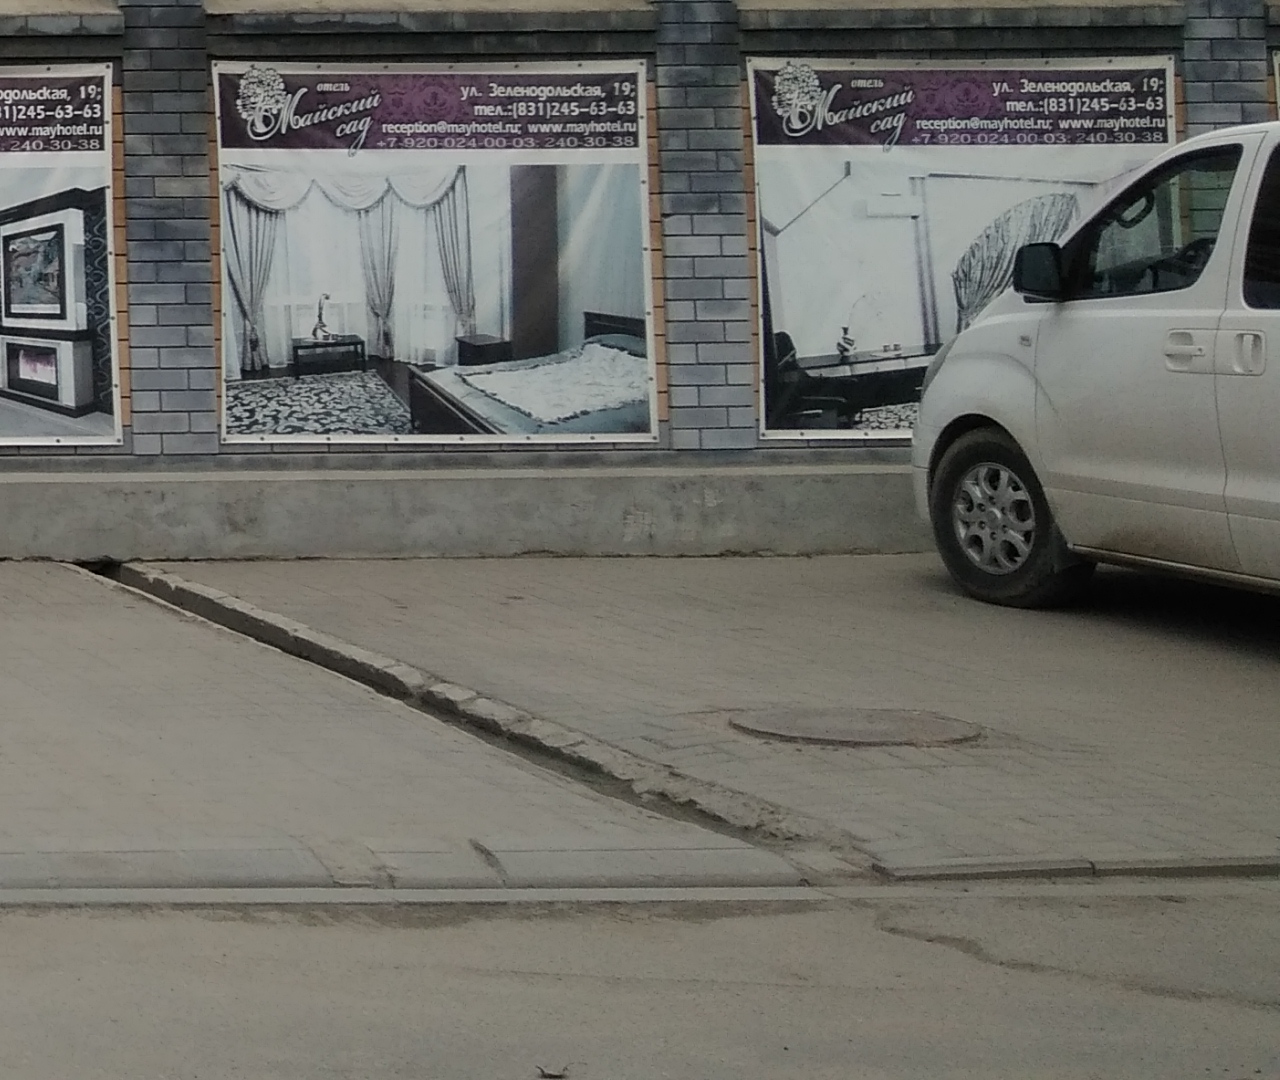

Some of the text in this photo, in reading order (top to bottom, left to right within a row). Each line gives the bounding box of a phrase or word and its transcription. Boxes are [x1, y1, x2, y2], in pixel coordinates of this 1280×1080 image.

[316, 82, 351, 92] отель
[851, 78, 884, 88] отель
[992, 77, 1165, 96] ул. Зеленодольская, 19;
[79, 85, 103, 101] 19;
[460, 82, 637, 101] ул. Зеленодольская, 19;
[277, 87, 383, 135] Майский
[813, 83, 916, 131] Майский
[382, 120, 637, 137] reception@mayhotel.ru; www.mayhotel.ru
[870, 112, 908, 154] сад
[916, 117, 1166, 133] reception@mayhotel.ru; www.mayhotel.ru
[10, 139, 101, 151] 240-30-38
[336, 116, 374, 158] сад
[544, 135, 636, 148] 240-30-38
[1076, 131, 1164, 144] 240-30-38
